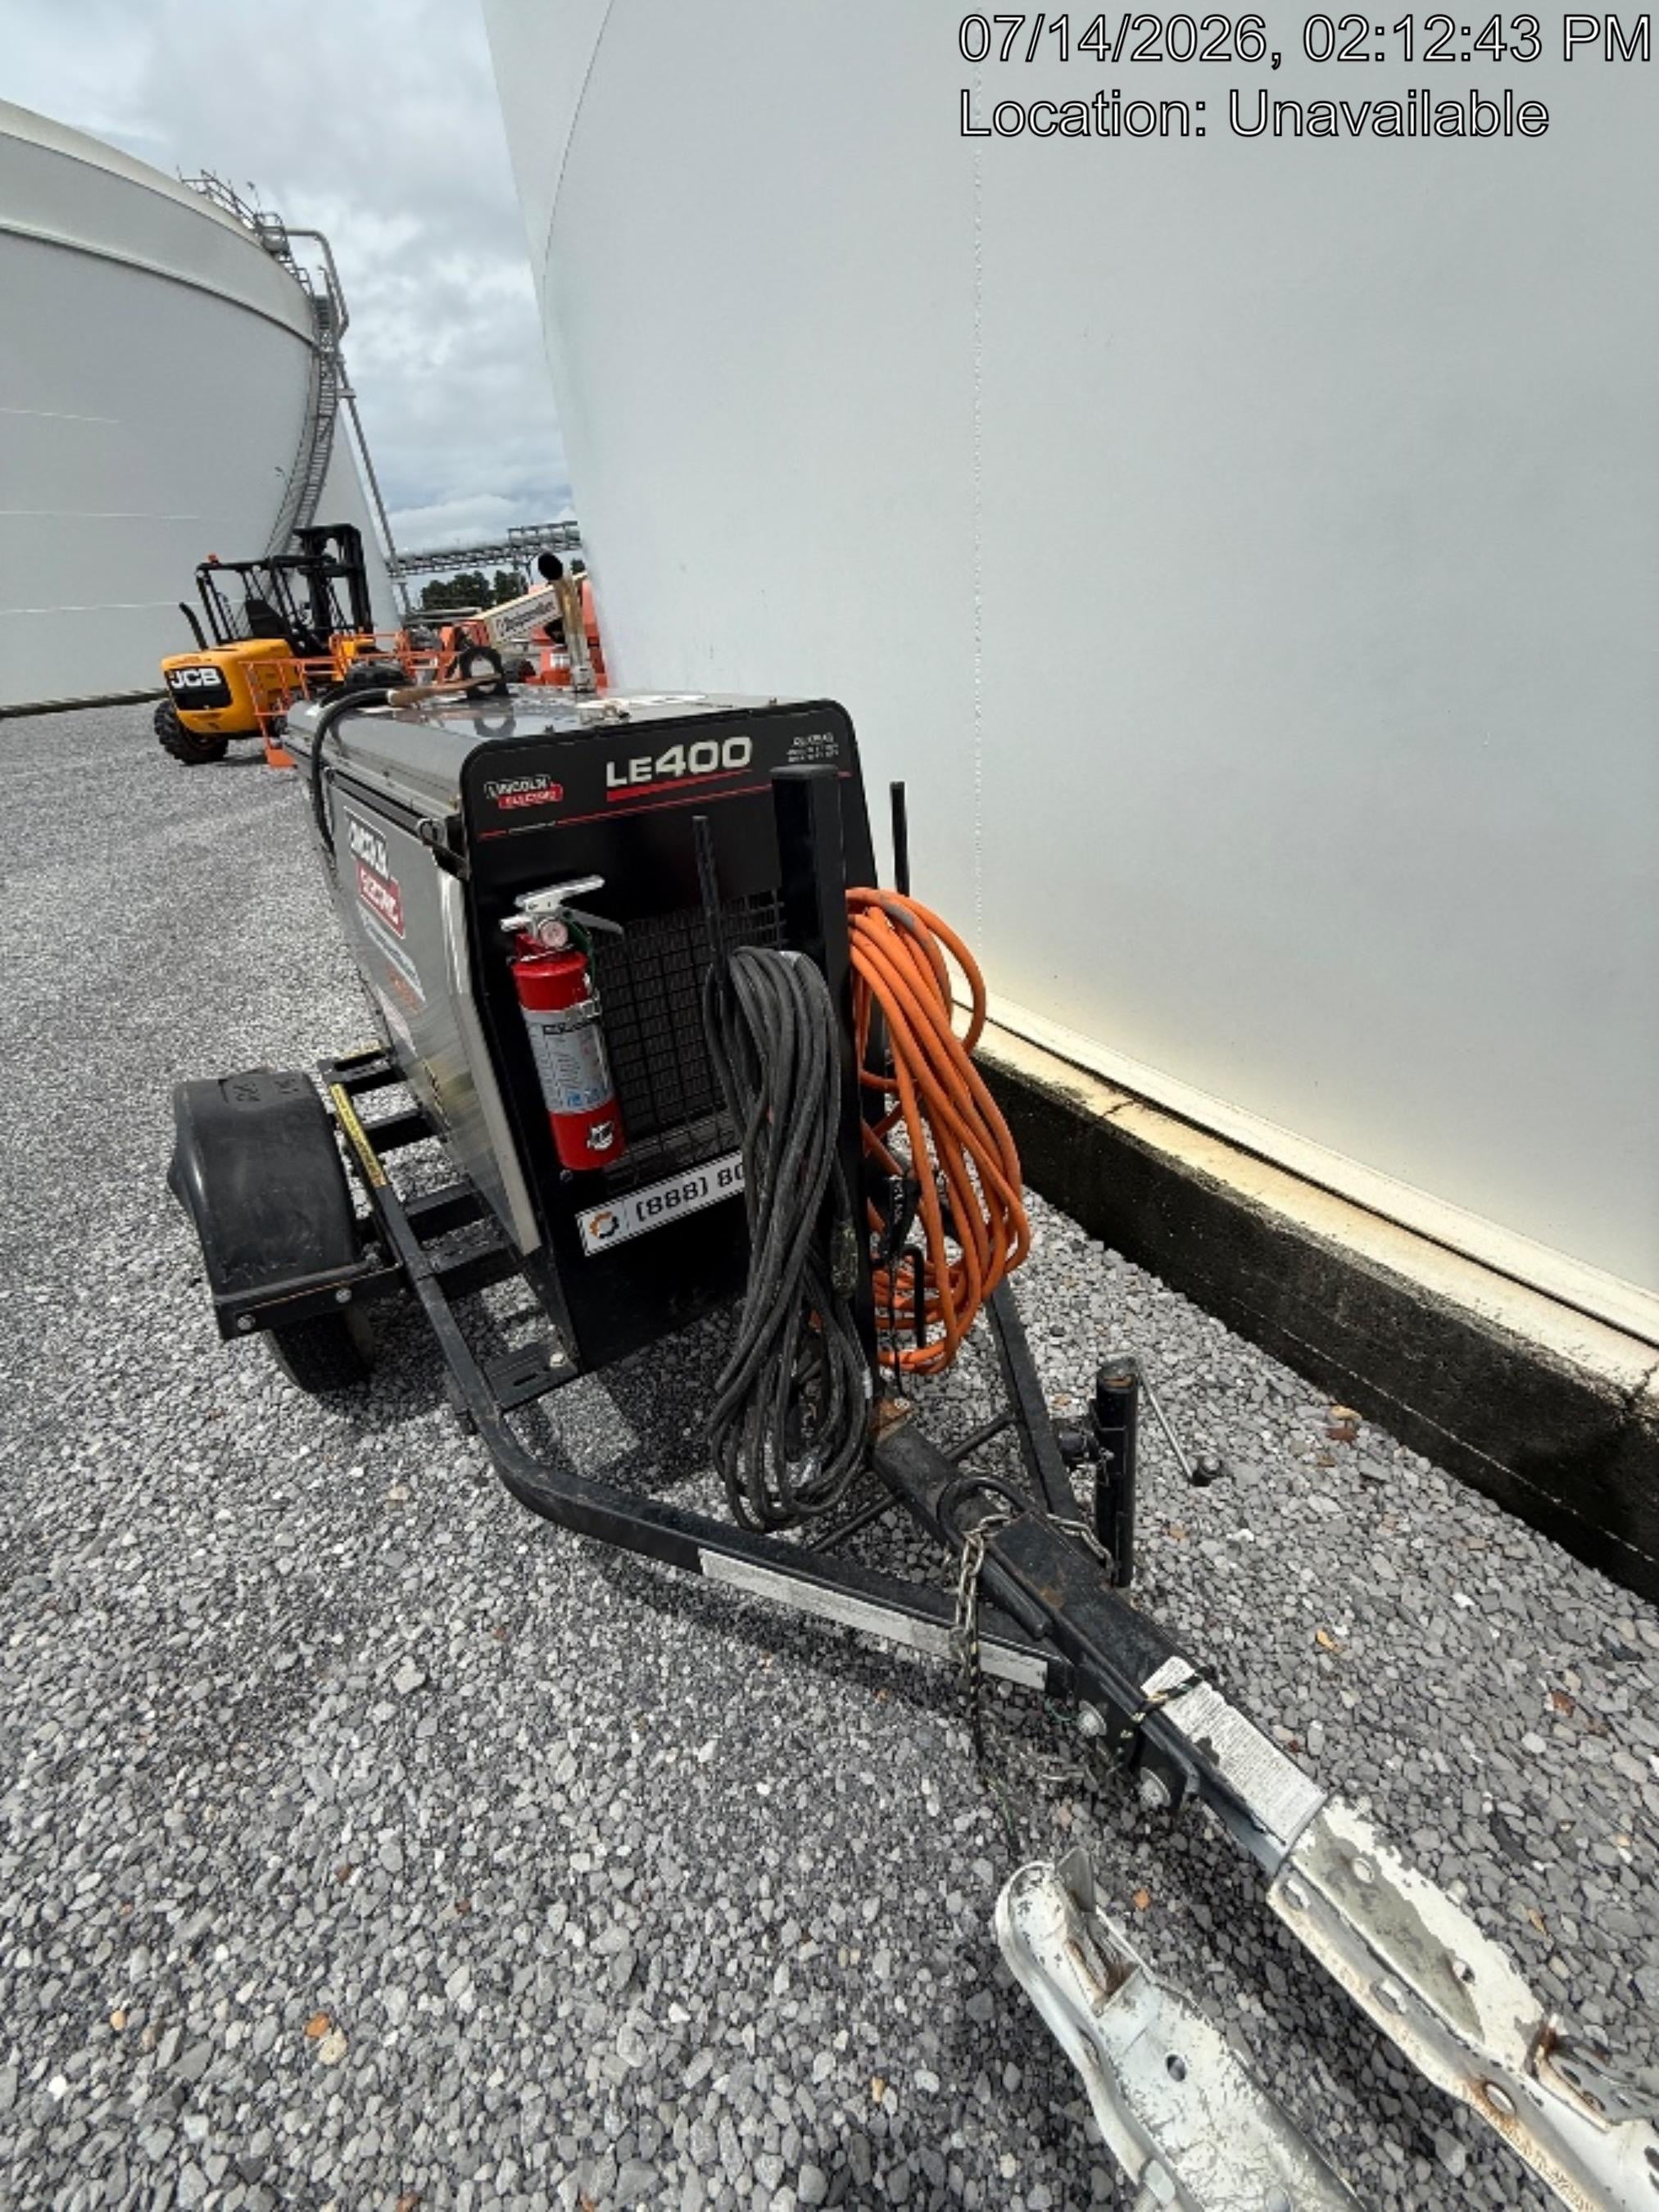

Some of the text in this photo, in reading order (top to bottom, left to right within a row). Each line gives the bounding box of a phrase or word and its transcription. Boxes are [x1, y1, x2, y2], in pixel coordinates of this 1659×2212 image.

[170, 668, 222, 689] JCB
[605, 737, 753, 788] LE400
[635, 1176, 709, 1223] (888)
